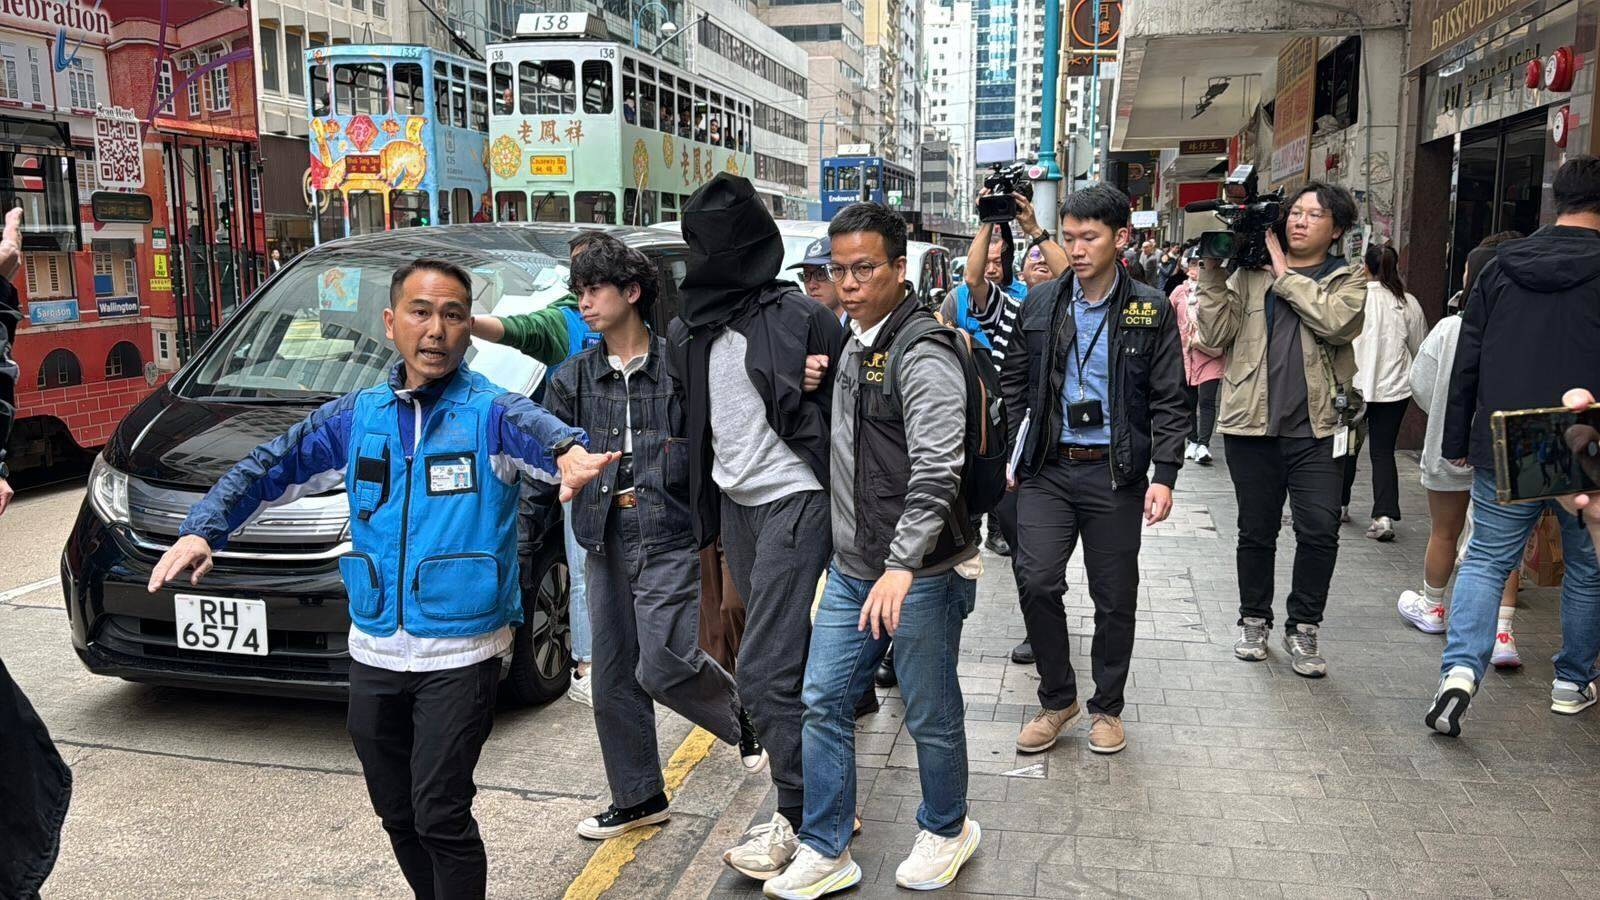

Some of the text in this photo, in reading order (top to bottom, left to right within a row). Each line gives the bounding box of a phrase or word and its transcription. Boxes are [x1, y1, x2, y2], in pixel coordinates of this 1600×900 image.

[534, 15, 569, 31] 138
[1430, 0, 1485, 51] BLISSFUL
[400, 48, 417, 57] 135
[491, 50, 504, 60] 138
[599, 48, 615, 59] 138
[518, 120, 584, 147] 老鳳祥
[681, 143, 714, 187] 老鳳祥
[99, 303, 137, 314] Wallington
[1125, 316, 1153, 325] OCTB
[866, 370, 884, 382] OC
[200, 599, 239, 626] RH
[183, 622, 260, 652] 6574
